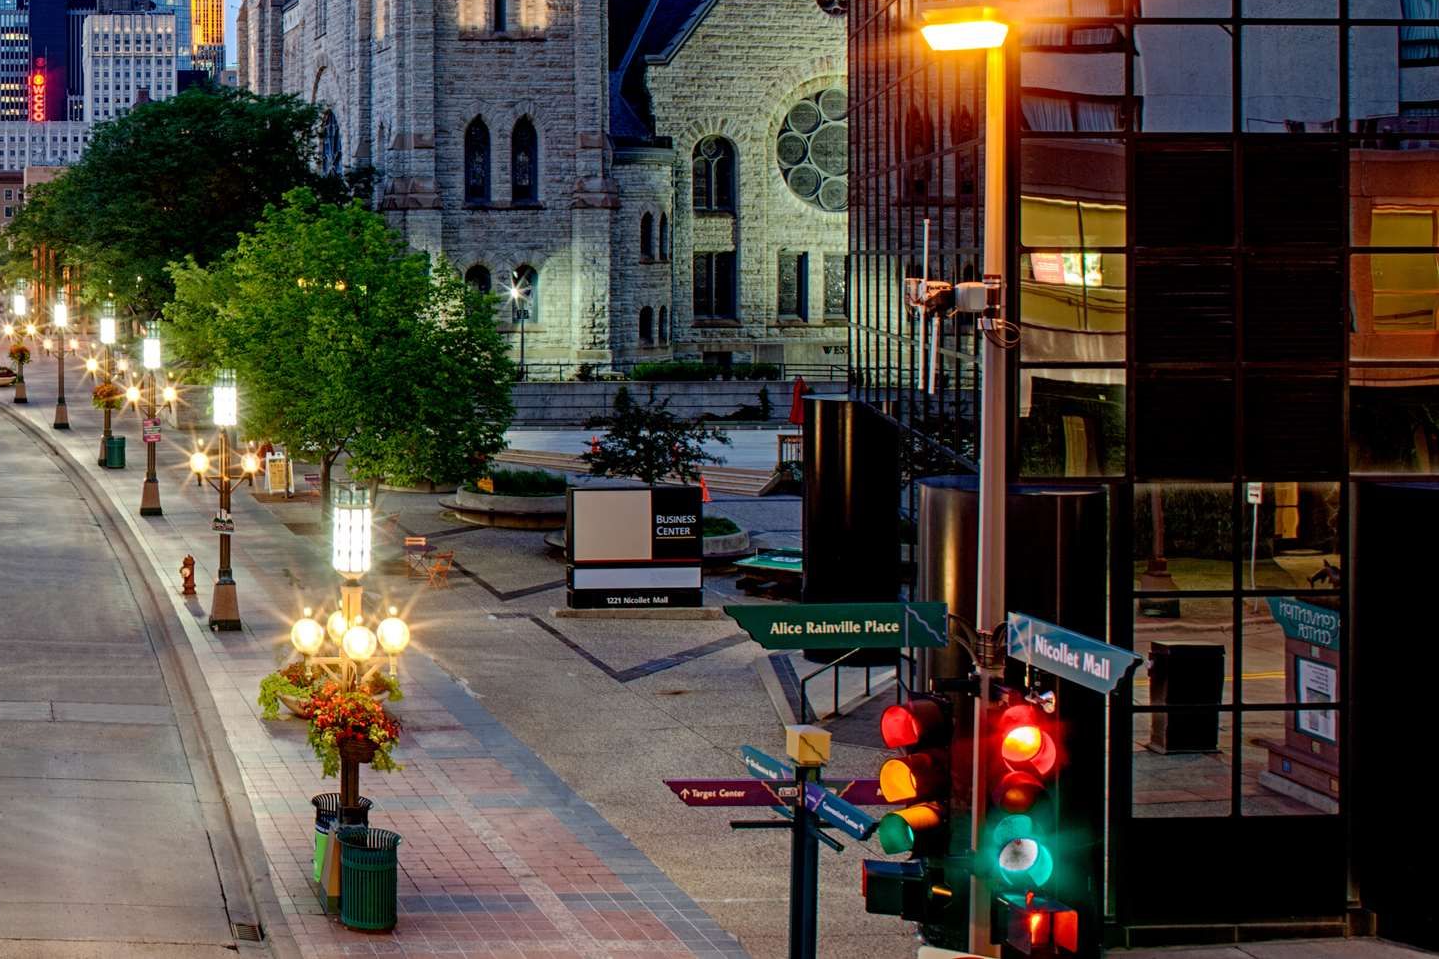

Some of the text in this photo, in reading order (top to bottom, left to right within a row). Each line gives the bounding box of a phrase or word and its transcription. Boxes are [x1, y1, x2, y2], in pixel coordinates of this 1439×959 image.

[33, 85, 45, 122] WCCO
[656, 515, 696, 524] BUSINESS
[656, 526, 691, 536] CENTER
[623, 596, 650, 604] Nicollet
[653, 596, 669, 604] Mall
[770, 619, 900, 634] Alice Rainville Place
[1035, 634, 1111, 680] Nicollet Mall
[692, 788, 746, 799] Target Center
